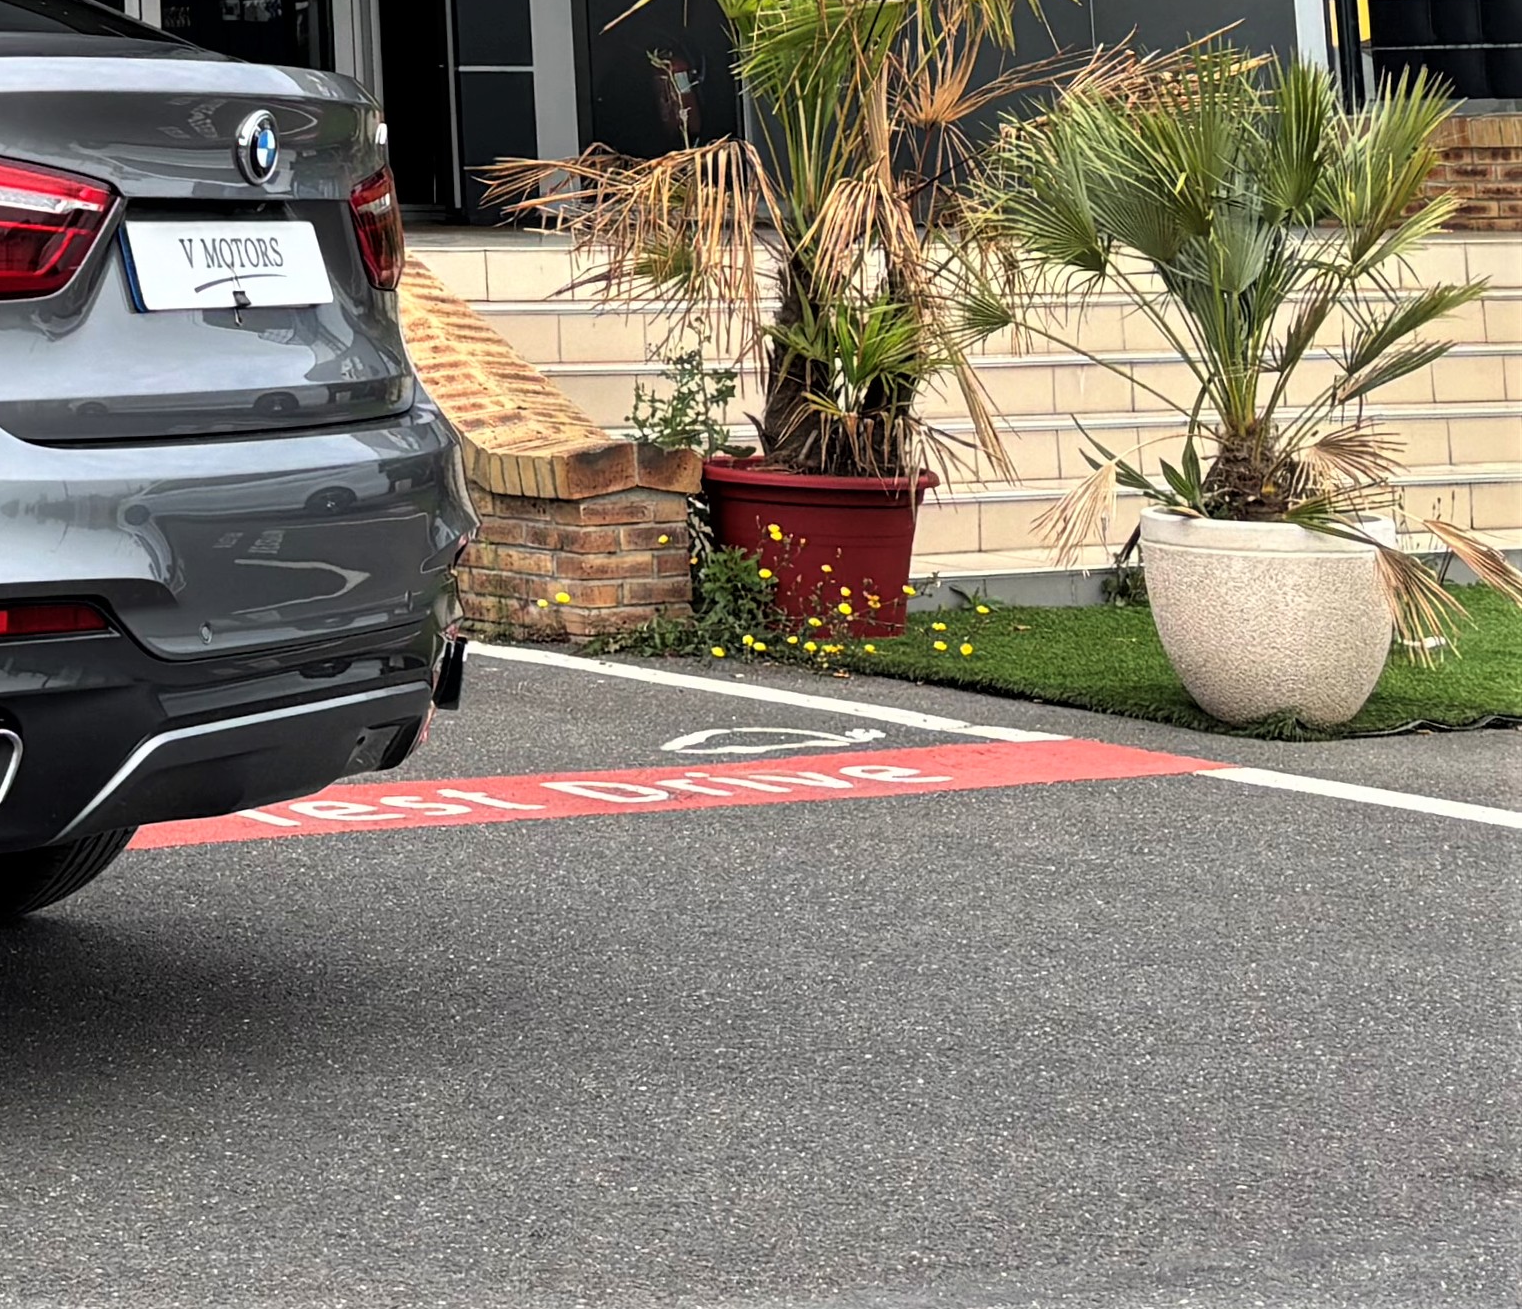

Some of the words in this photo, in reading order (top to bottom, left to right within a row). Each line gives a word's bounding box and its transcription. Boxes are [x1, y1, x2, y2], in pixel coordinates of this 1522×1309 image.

[178, 238, 194, 269] V
[199, 237, 284, 269] MOTORS
[542, 764, 954, 804] Drive
